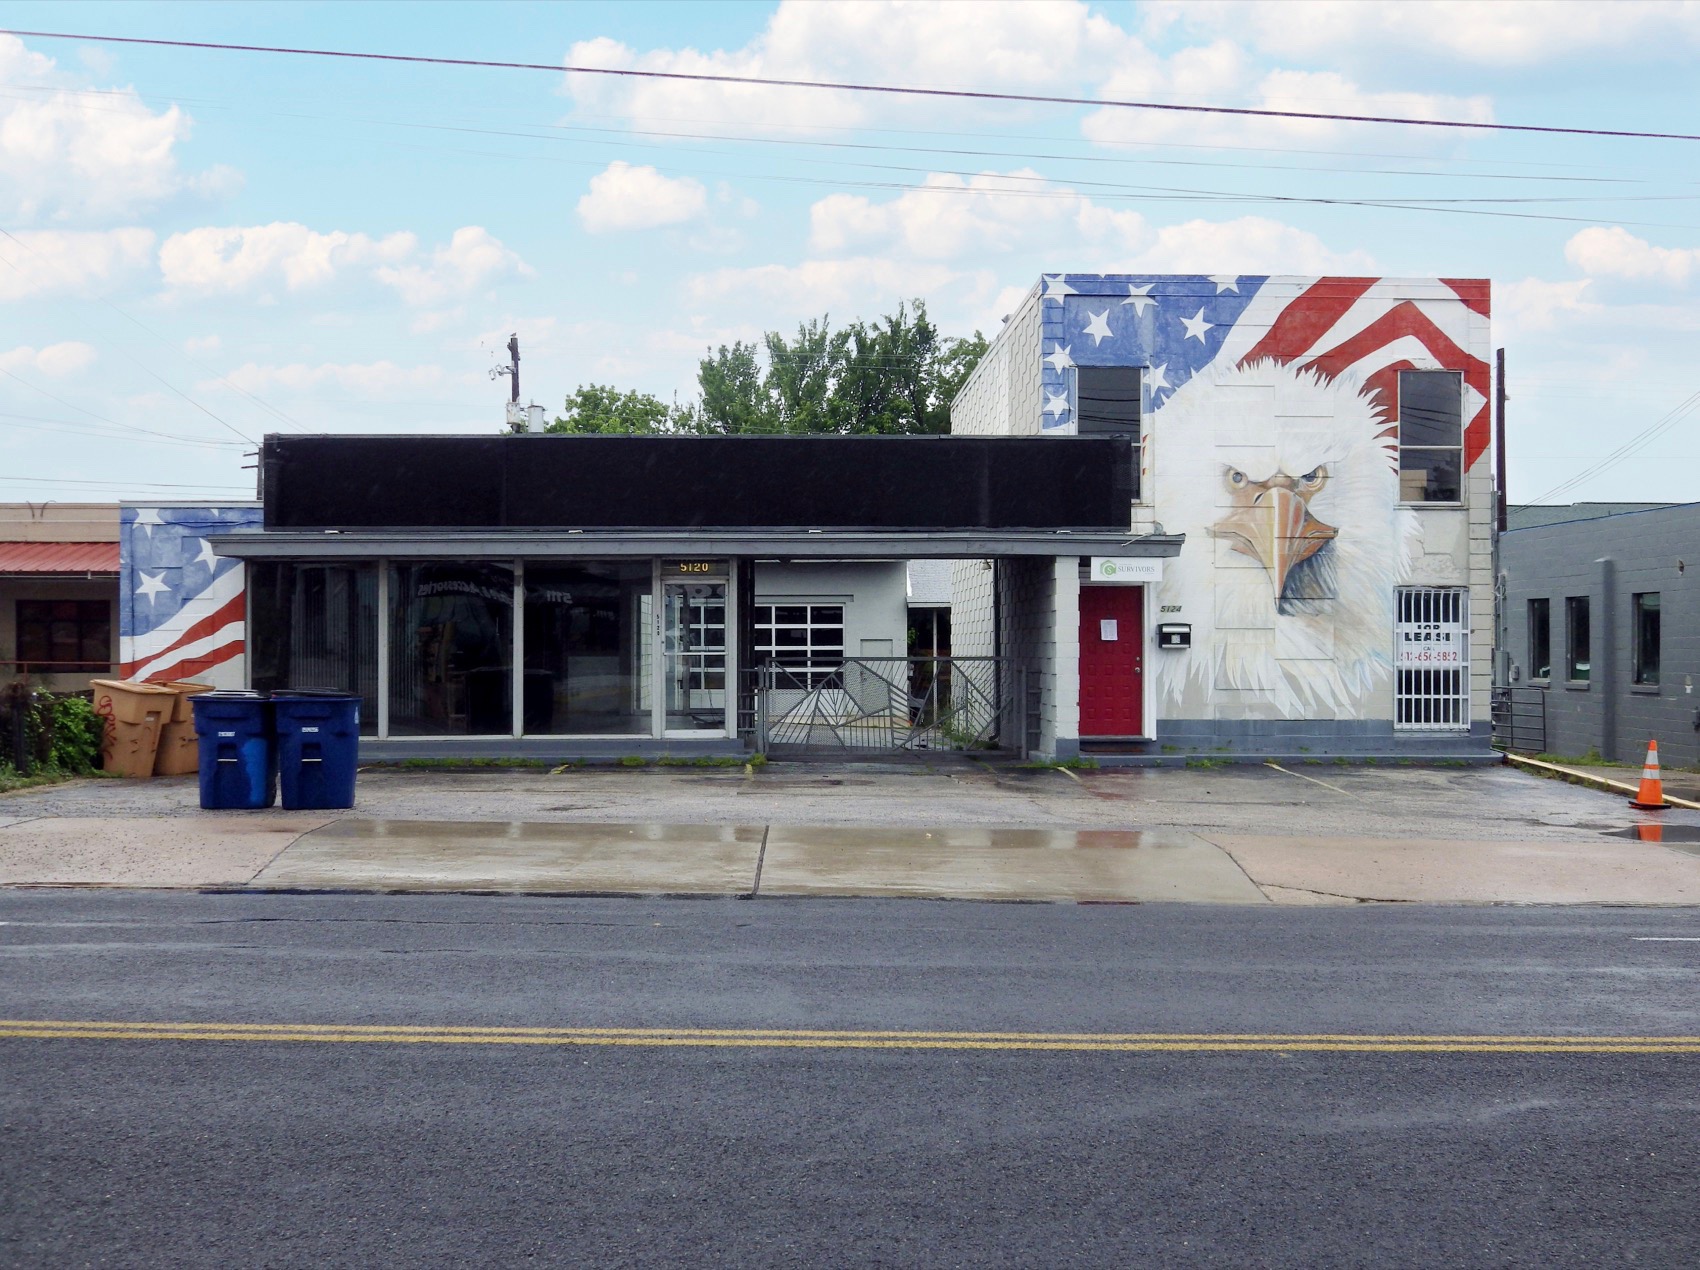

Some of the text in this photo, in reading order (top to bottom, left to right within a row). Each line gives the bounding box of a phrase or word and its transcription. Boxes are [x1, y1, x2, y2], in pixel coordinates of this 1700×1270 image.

[680, 563, 709, 572] 5120
[1118, 565, 1155, 573] SURVIVORS
[1160, 605, 1182, 613] 5124
